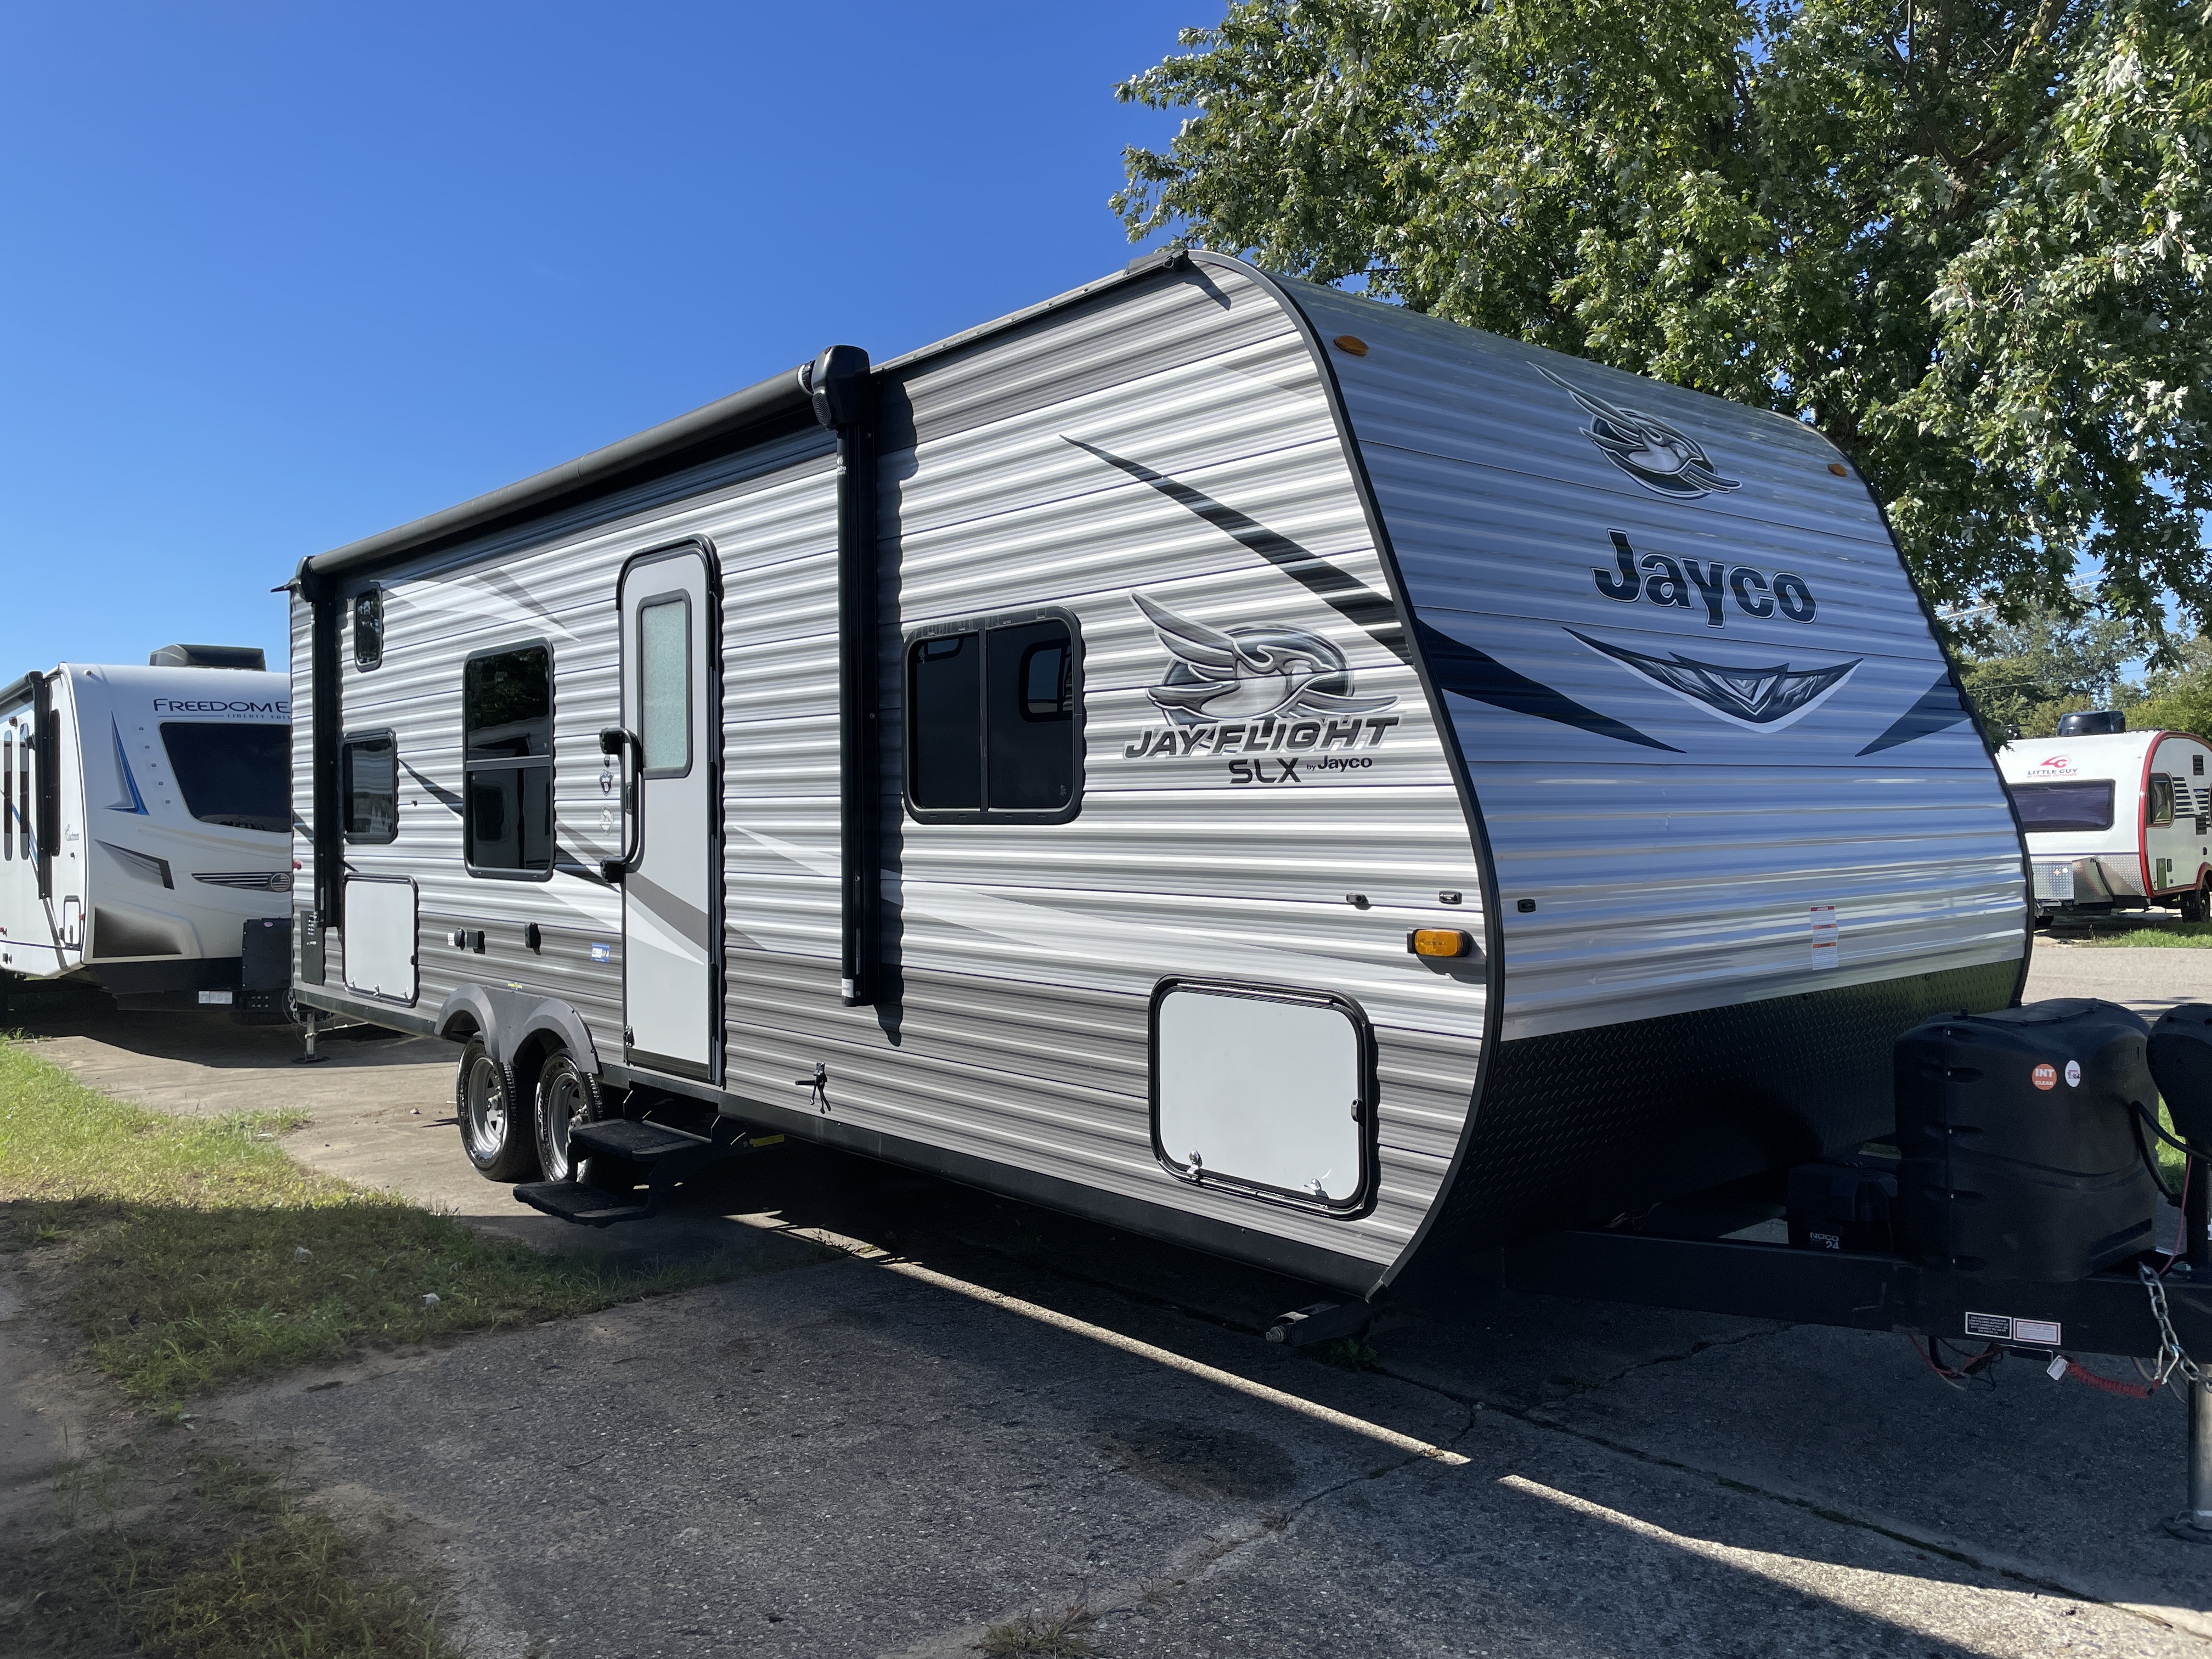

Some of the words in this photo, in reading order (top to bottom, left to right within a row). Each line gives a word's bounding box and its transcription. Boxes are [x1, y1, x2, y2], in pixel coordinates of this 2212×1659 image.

[1590, 528, 1817, 628] Jayco
[153, 698, 273, 713] FREEDOM
[1228, 757, 1301, 784] SLX
[1317, 755, 1372, 772] Jayco
[2035, 1068, 2054, 1077] INT
[1810, 1232, 1839, 1242] NOCO
[1825, 1240, 1840, 1249] 24
